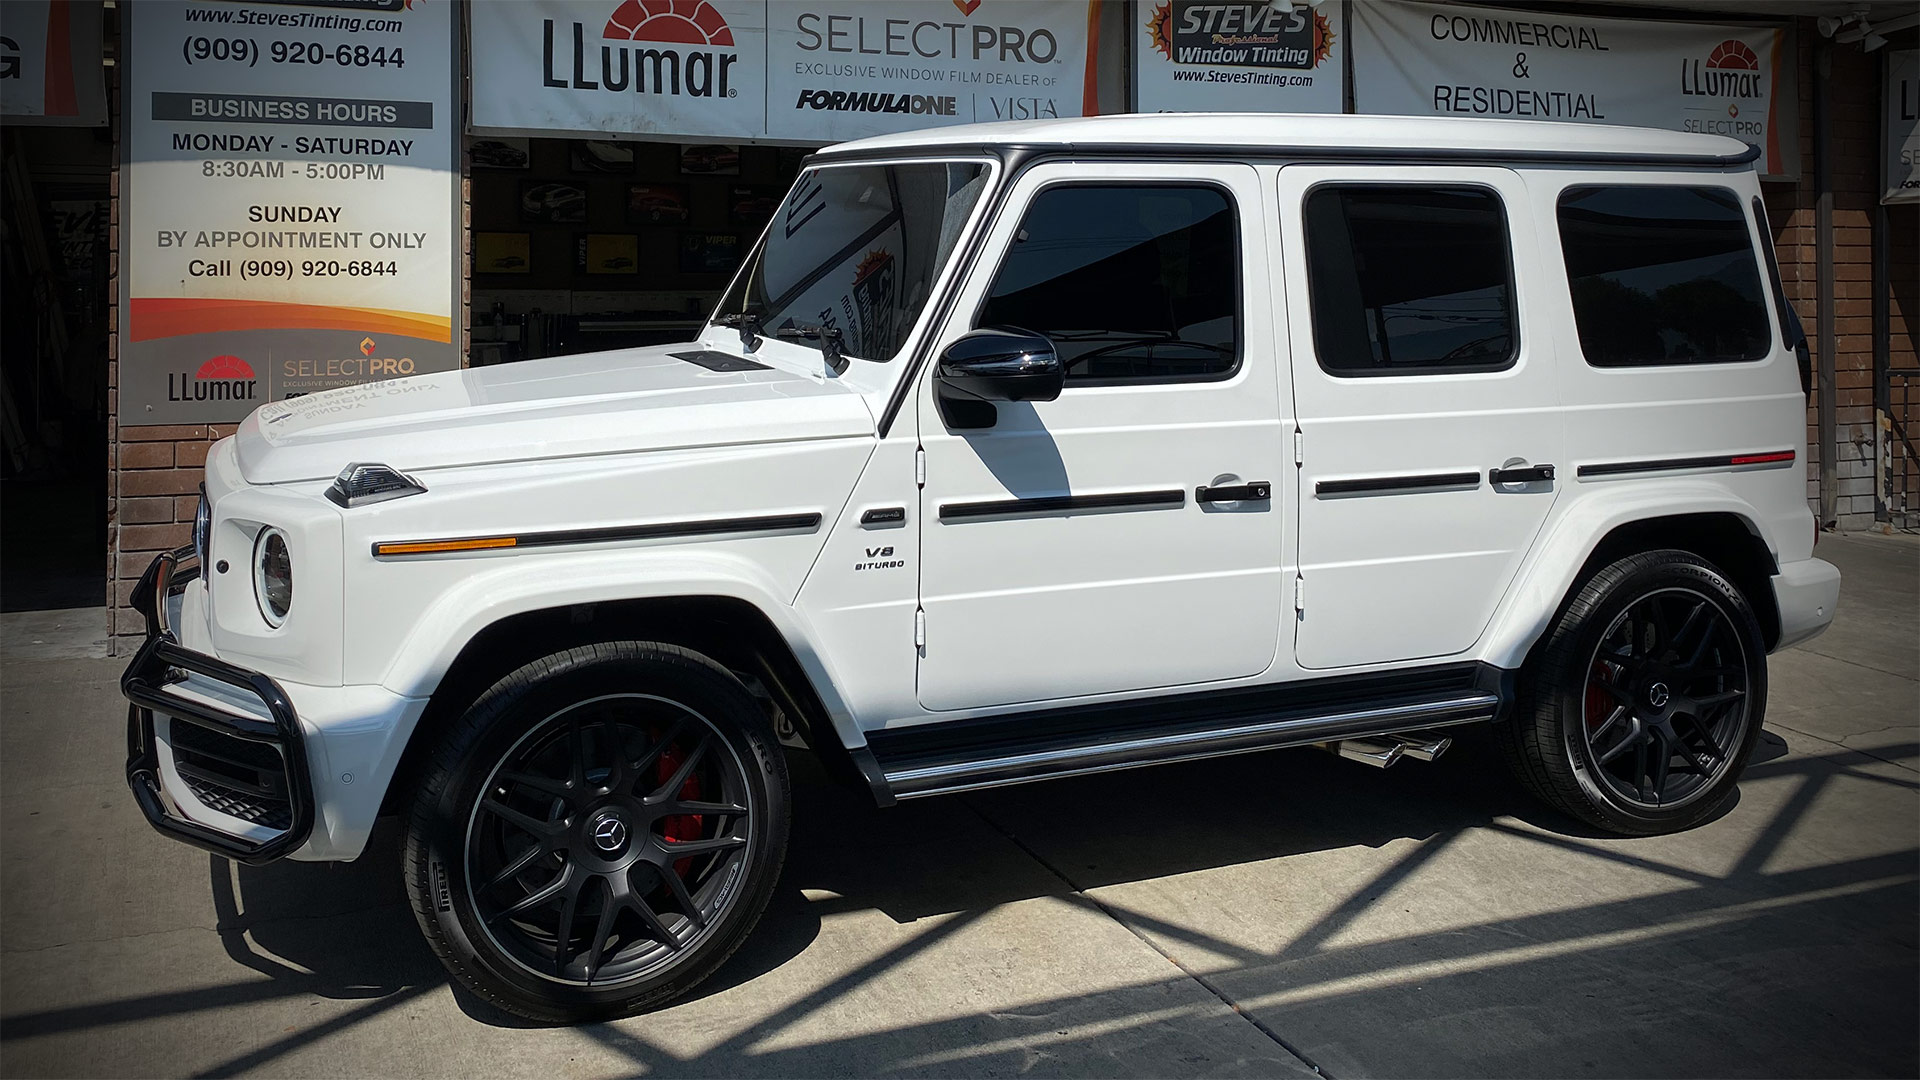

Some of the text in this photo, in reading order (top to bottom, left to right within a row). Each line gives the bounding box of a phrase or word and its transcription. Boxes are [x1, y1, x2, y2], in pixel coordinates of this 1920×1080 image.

[185, 9, 403, 33] www.StevesTinting.com
[1431, 14, 1609, 51] COMMERCIAL
[183, 35, 405, 68] (909) 920-6844
[1178, 46, 1308, 66] Window Tinting
[795, 62, 1057, 86] EXCLUSIVE WINDOW FILM DEALER OF
[1512, 52, 1530, 78] &
[1173, 70, 1313, 88] www.StevesTinting.com
[191, 98, 397, 123] BUSINESS HOURS
[796, 89, 1058, 120] FORMULAONE VISTA
[1434, 85, 1605, 119] RESIDENTIAL
[1683, 119, 1762, 136] SELECTPRO
[172, 133, 274, 152] MONDAY
[295, 137, 414, 156] SATURDAY
[202, 160, 284, 178] 8:30AM
[306, 163, 385, 181] 5:00PM
[248, 205, 342, 223] SUNDAY
[157, 230, 427, 249] BY APPOINTMENT ONLY
[188, 260, 398, 281] Call (909) 920-6844
[168, 373, 257, 402] LLumar
[283, 380, 324, 388] EXCLUSIVE
[325, 379, 357, 387] WINDOW
[865, 546, 894, 558] V8
[855, 560, 904, 571] BITURBO
[1662, 567, 1730, 593] SCORPION
